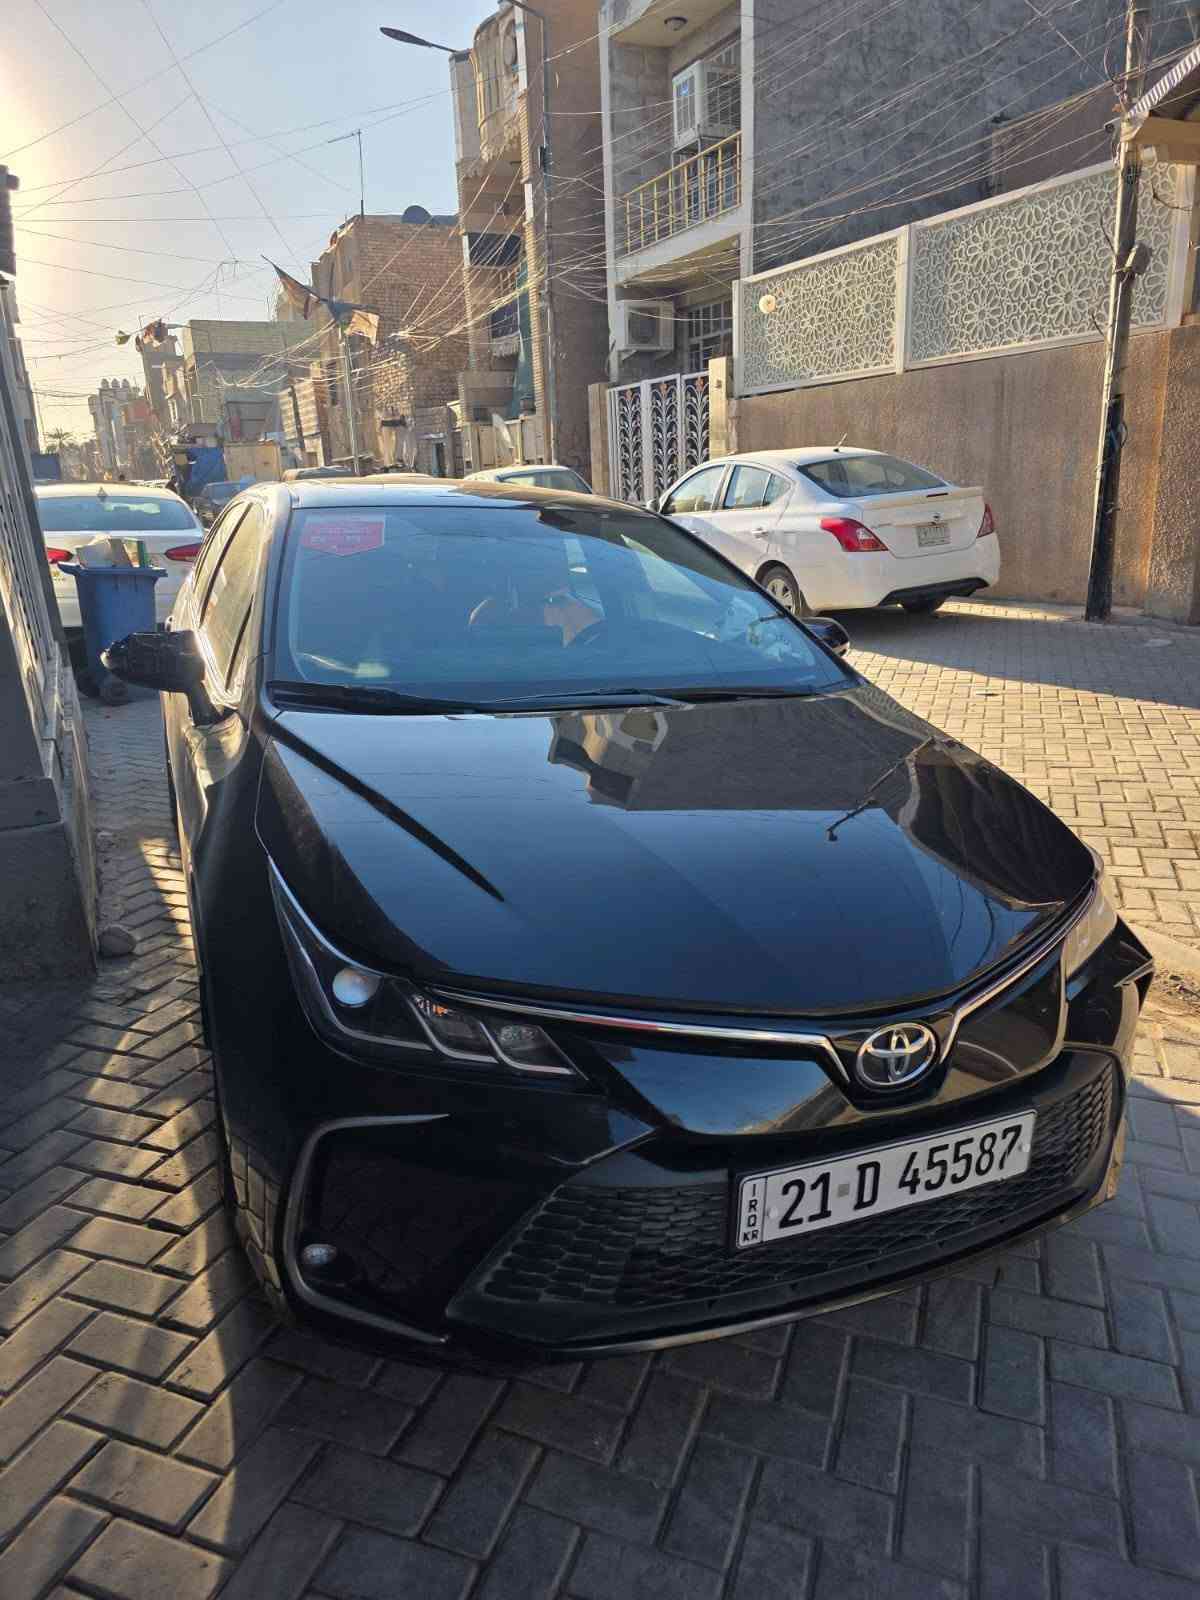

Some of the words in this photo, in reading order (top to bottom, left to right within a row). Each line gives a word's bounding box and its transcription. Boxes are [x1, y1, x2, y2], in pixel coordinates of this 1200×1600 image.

[779, 1172, 832, 1229] 21
[853, 1160, 881, 1210] D
[898, 1123, 1022, 1195] 45587
[743, 1229, 759, 1242] KR
